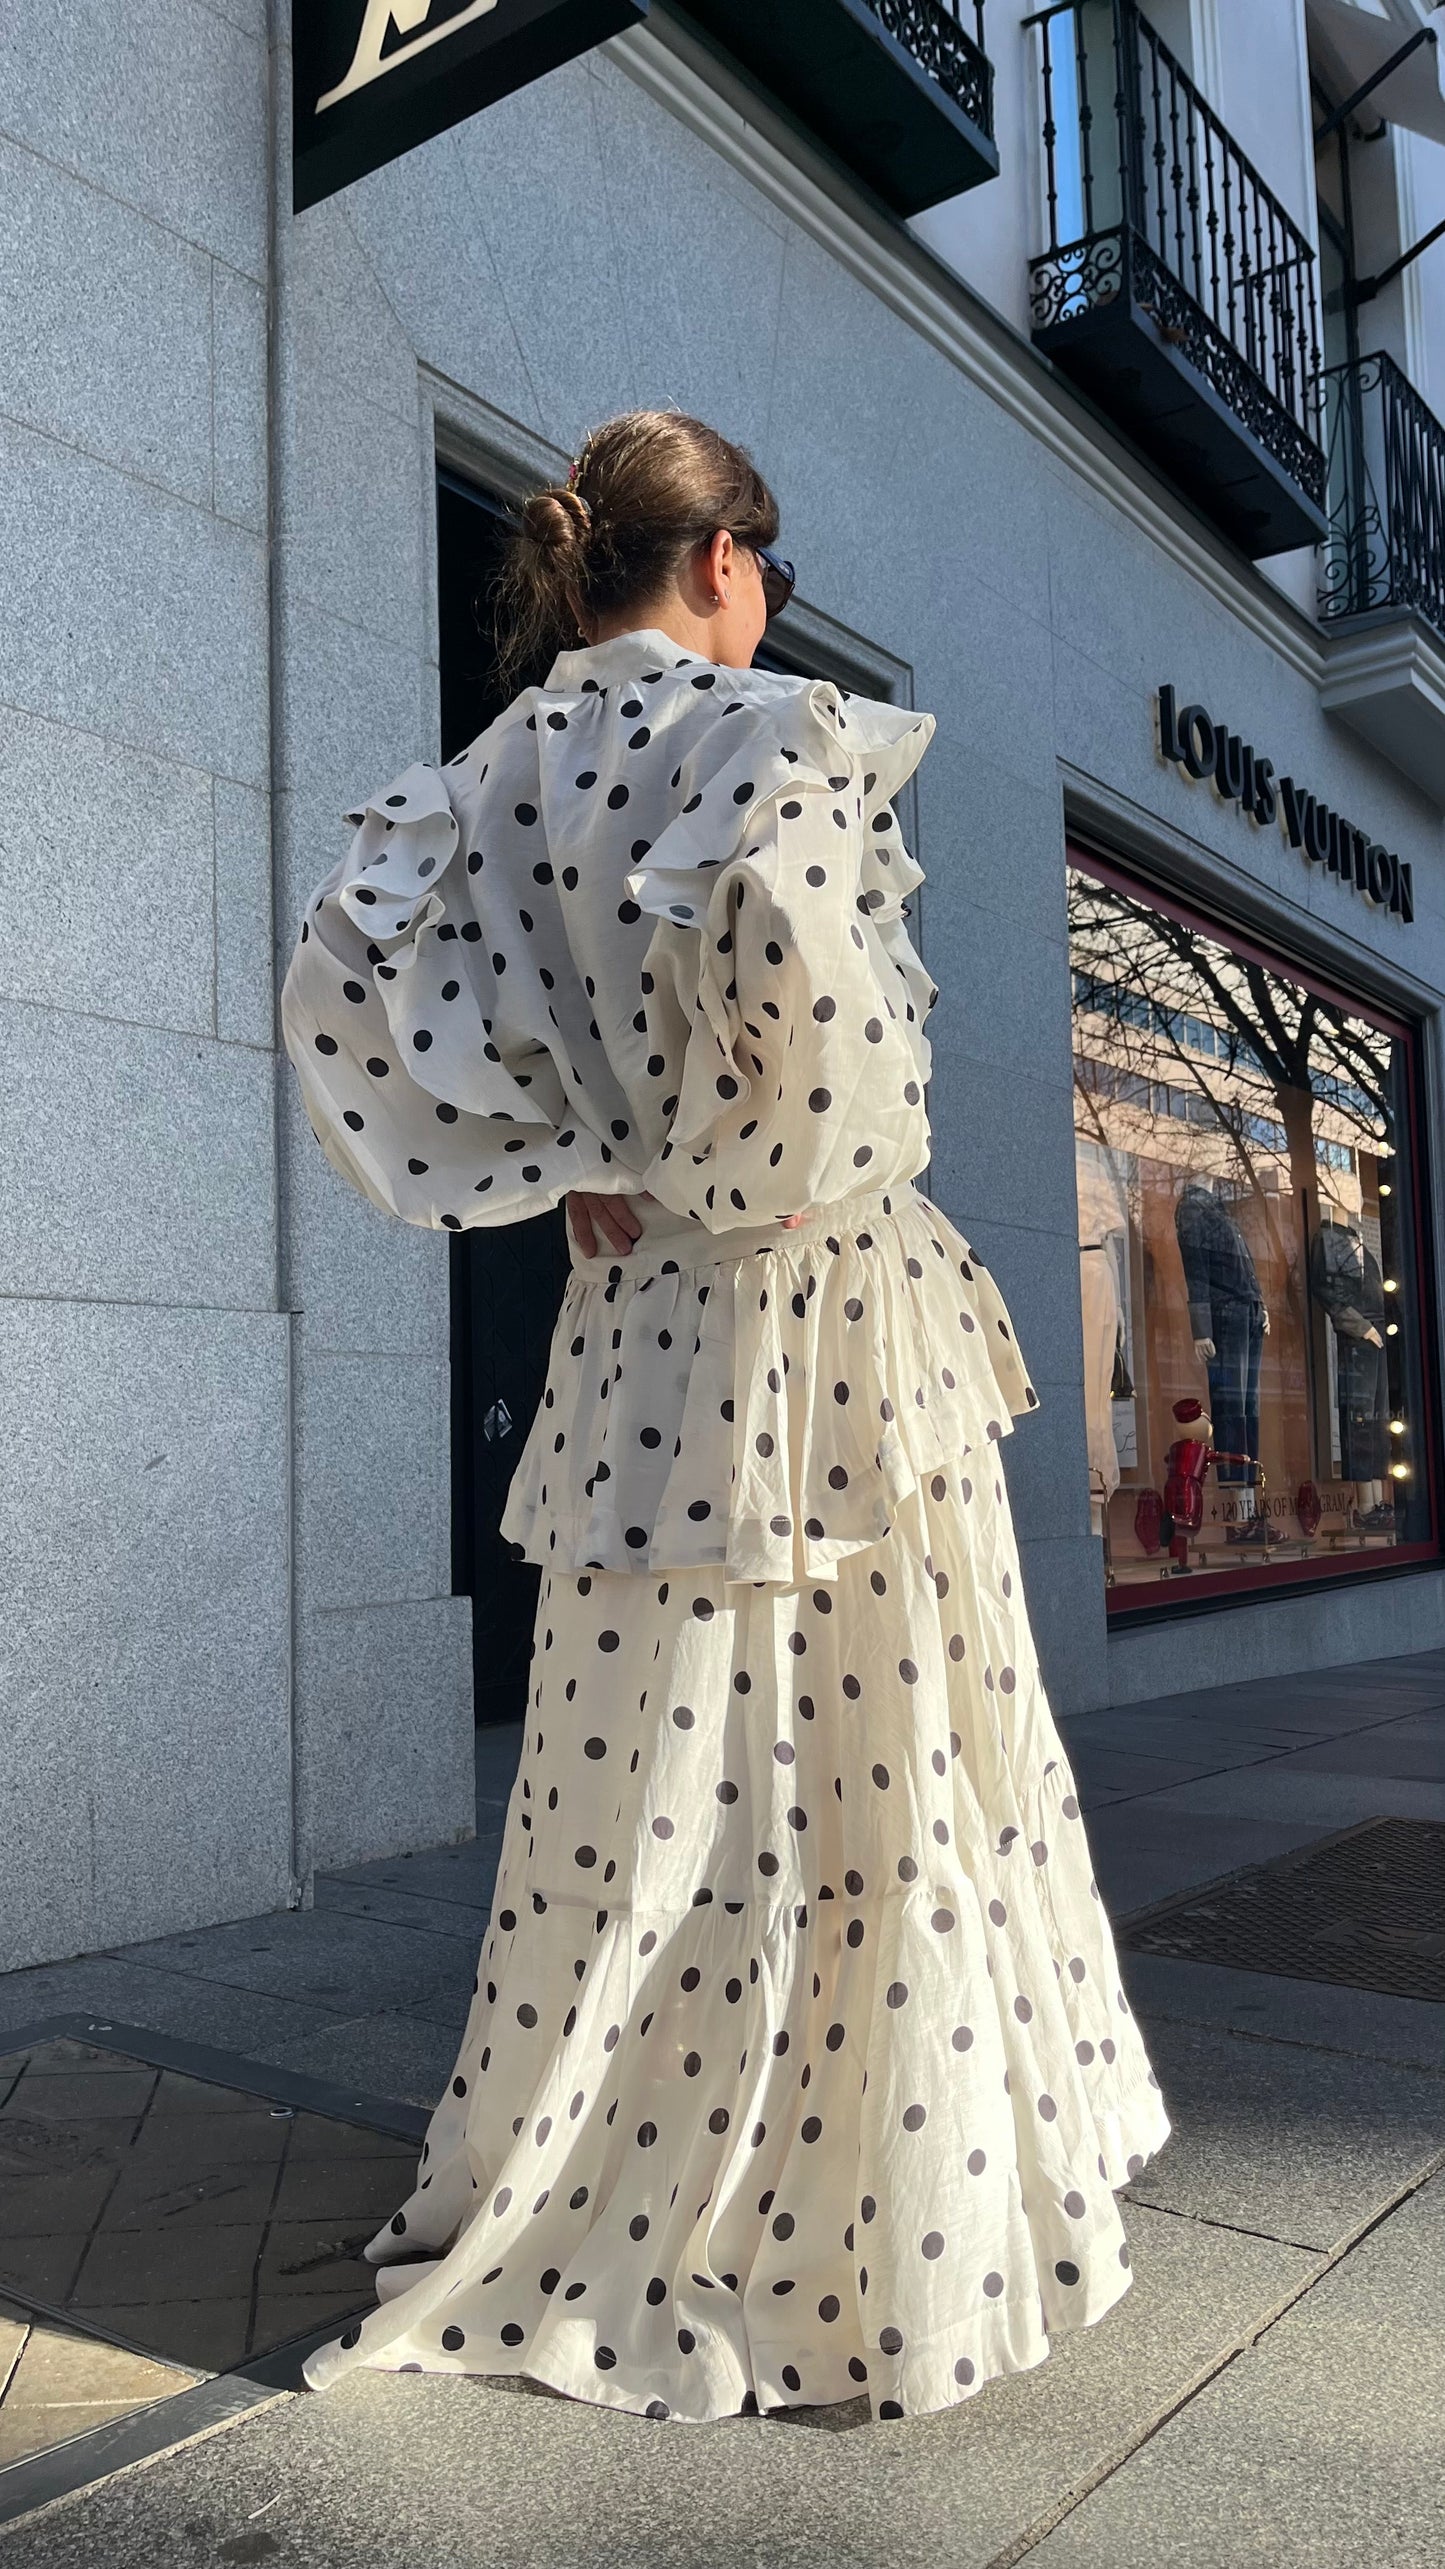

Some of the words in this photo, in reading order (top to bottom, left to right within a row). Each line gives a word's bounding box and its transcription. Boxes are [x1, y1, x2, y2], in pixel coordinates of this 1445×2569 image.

[1158, 683, 1276, 825] LOUIS
[1279, 776, 1414, 924] VUITTON
[1239, 1498, 1272, 1520] YEARS
[1274, 1497, 1287, 1517] OF
[1289, 1492, 1347, 1516] MGRAM
